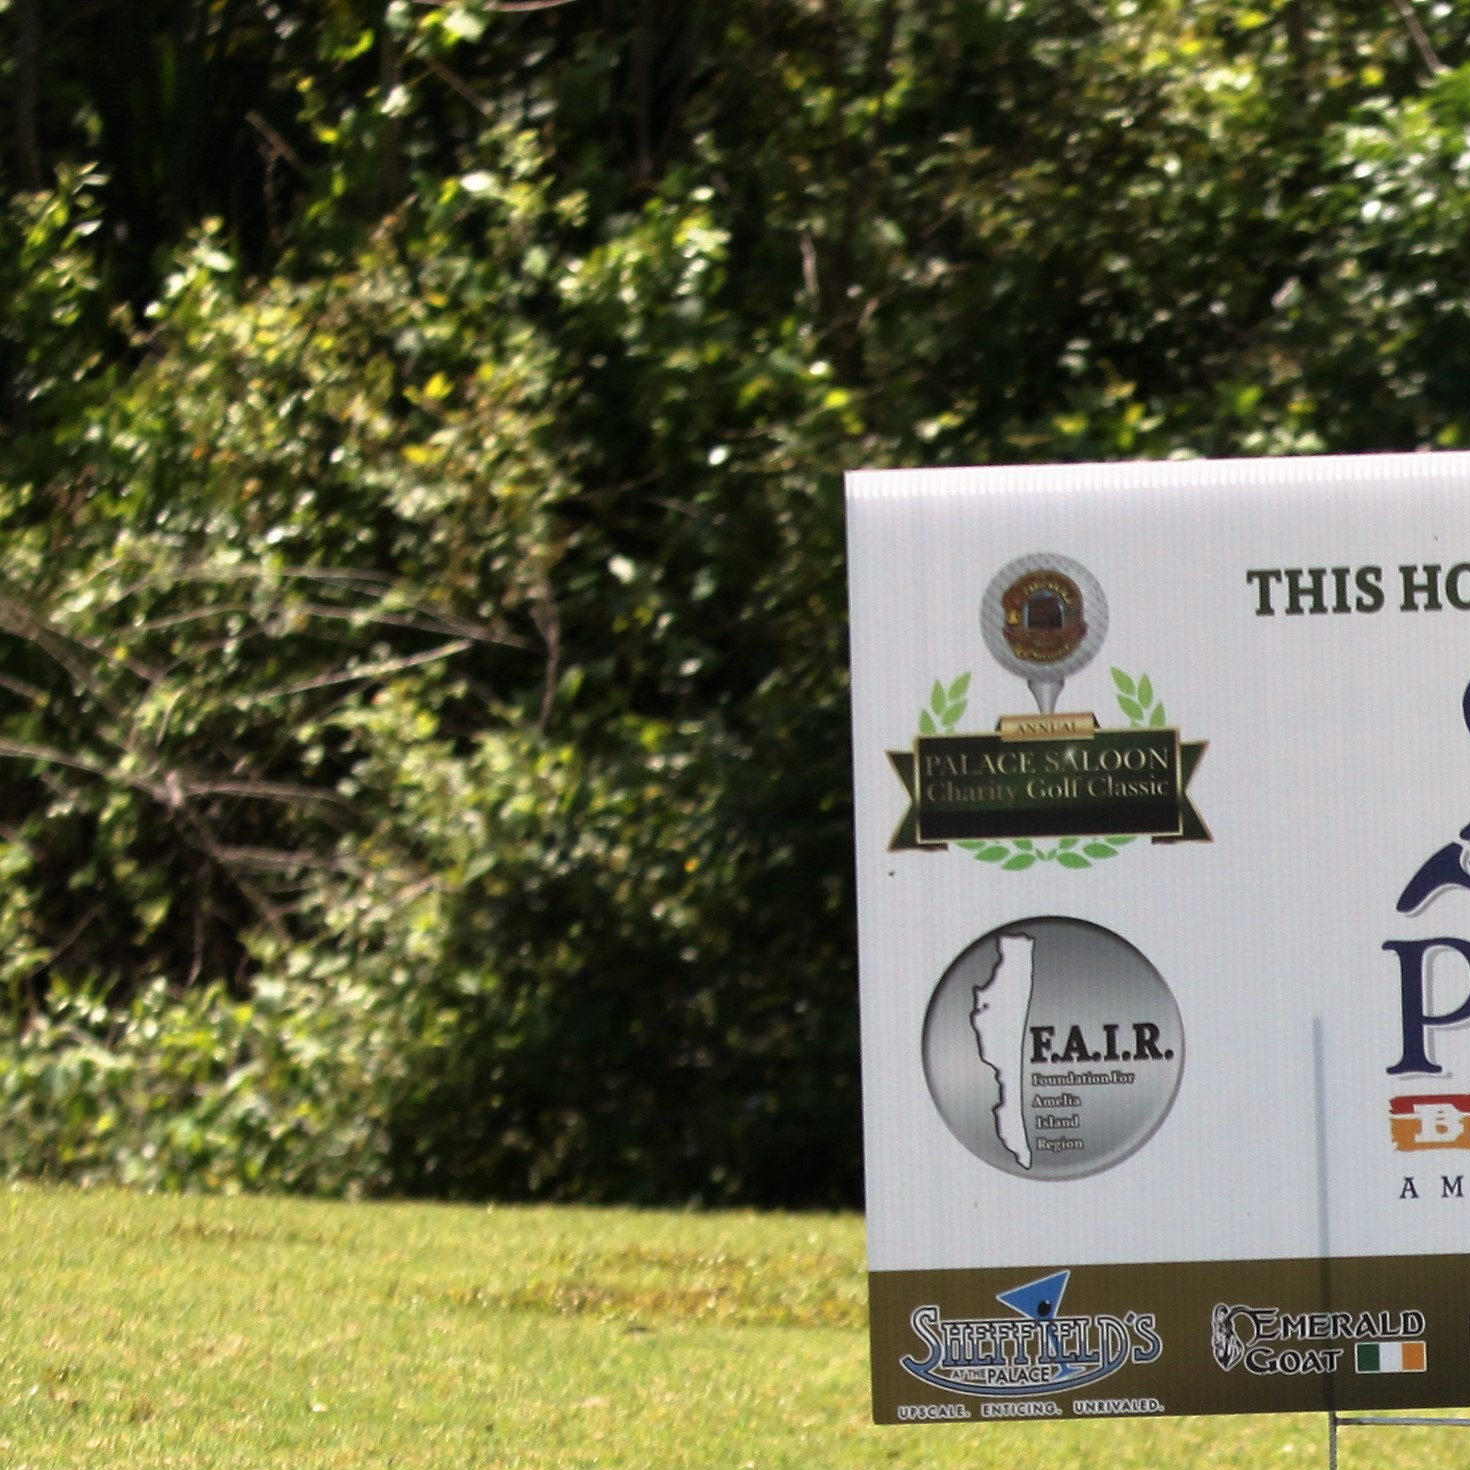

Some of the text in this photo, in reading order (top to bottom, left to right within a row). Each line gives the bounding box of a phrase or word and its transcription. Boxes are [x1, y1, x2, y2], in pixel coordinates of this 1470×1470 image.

[1247, 566, 1384, 616] THIS
[925, 747, 1169, 777] PALACE SALOON
[927, 775, 1169, 806] Charity Golf Classic
[1030, 1022, 1174, 1064] F.A.I.R.
[1032, 1070, 1135, 1087] Foundation For
[1032, 1093, 1081, 1108] Amelia
[1036, 1115, 1080, 1129] Island
[1037, 1137, 1084, 1152] Region
[987, 1367, 1050, 1383] PALACE
[899, 1399, 1164, 1419] UPSCALE. ENTICING. UNRIVALED.
